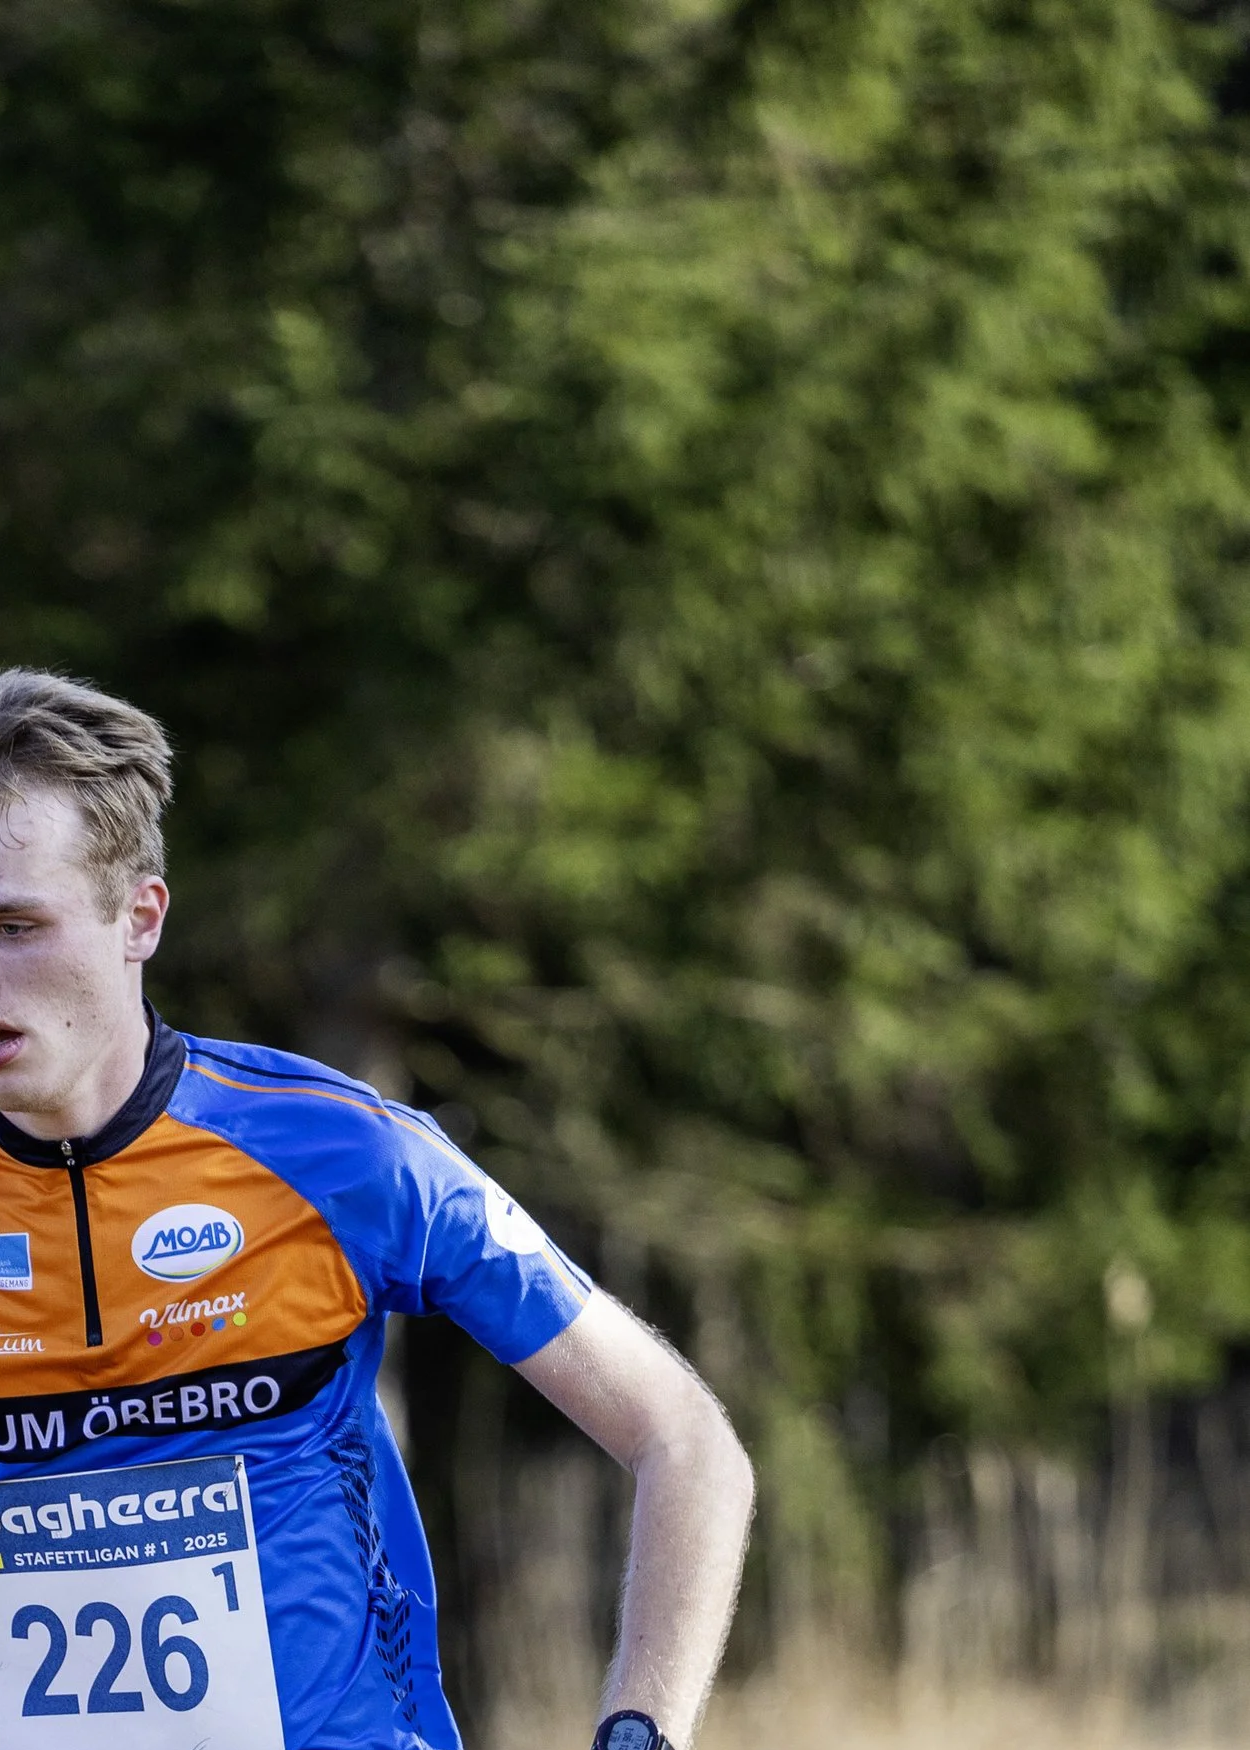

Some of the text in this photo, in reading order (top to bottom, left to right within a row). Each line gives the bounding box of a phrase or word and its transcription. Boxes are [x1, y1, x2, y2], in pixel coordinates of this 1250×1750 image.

[141, 1222, 232, 1261] MOAB
[82, 1374, 281, 1441] ÖREBRO
[13, 1545, 140, 1568] STAFETTLIGAN
[184, 1532, 228, 1552] 2025
[211, 1561, 240, 1613] 1
[11, 1595, 209, 1718] 226
